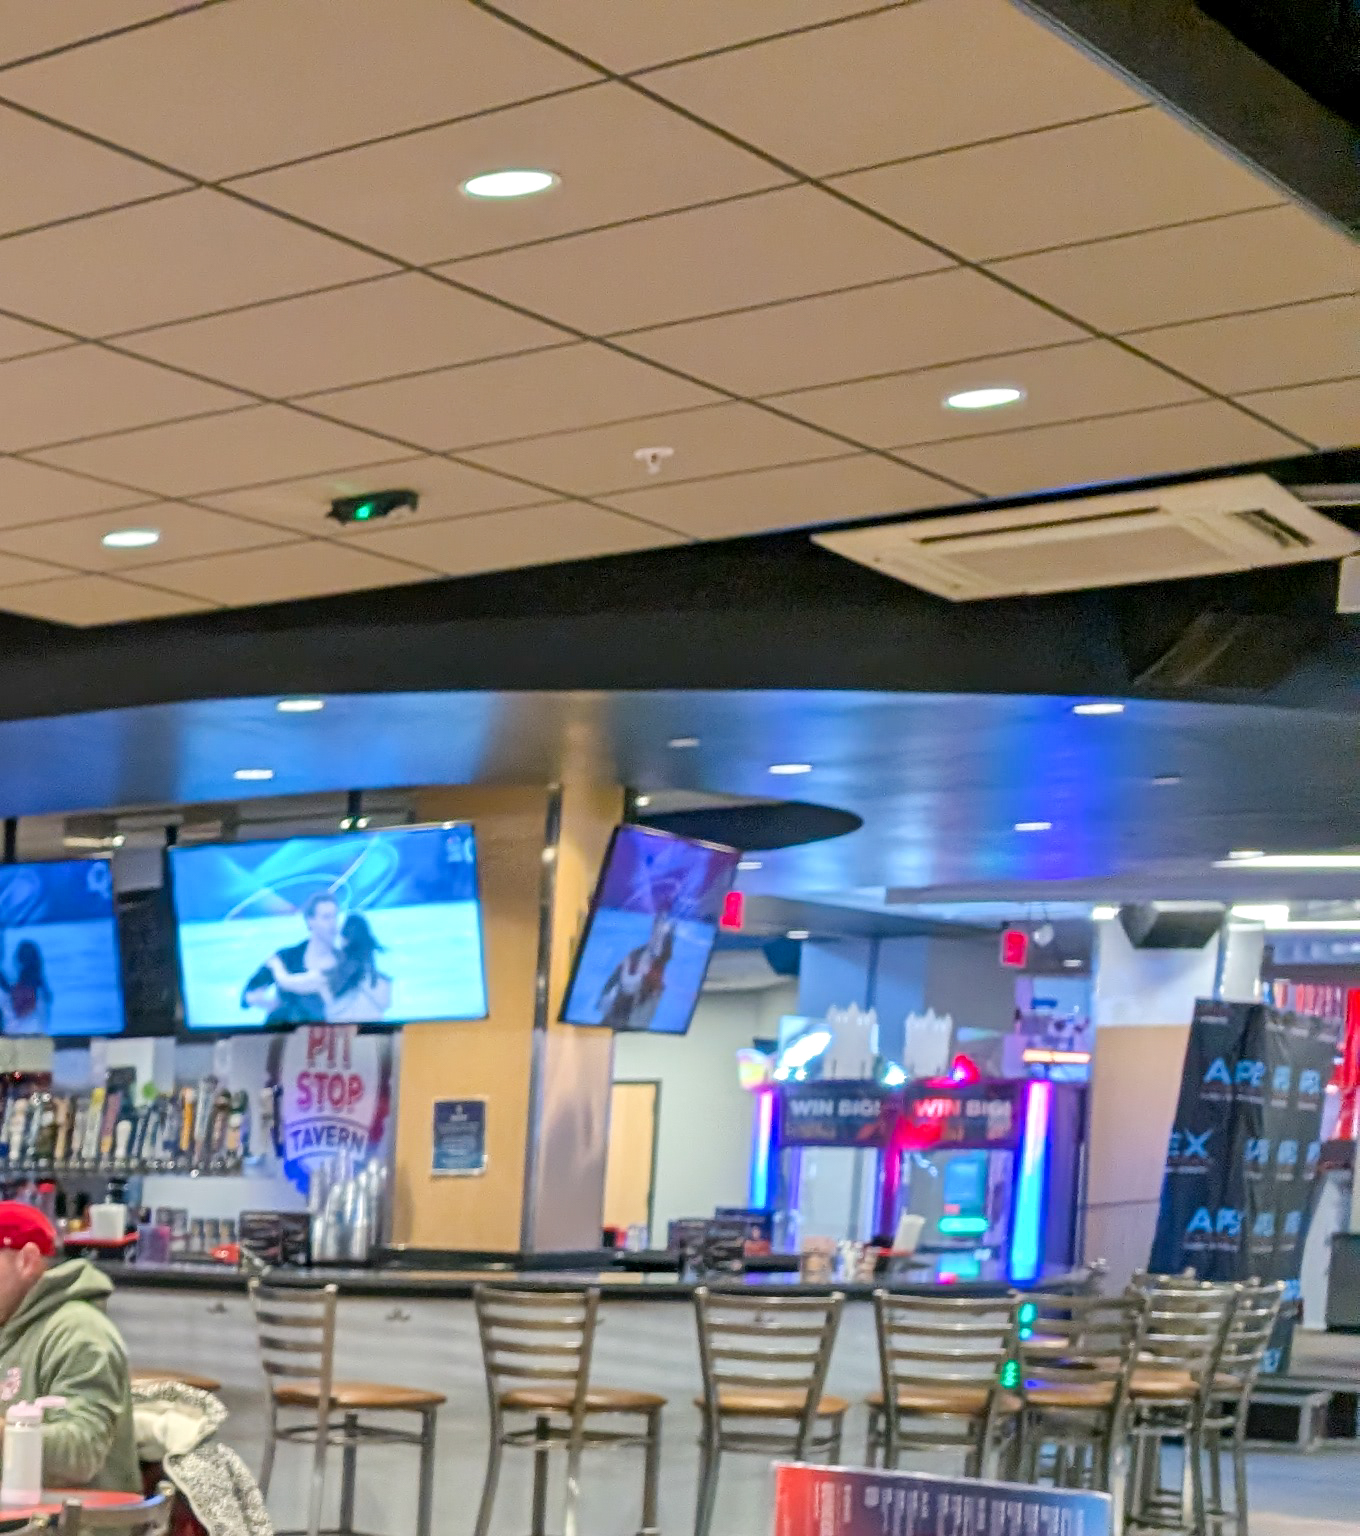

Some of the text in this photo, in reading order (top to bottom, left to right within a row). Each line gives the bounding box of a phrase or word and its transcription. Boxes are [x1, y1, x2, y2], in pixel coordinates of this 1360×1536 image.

[296, 1071, 364, 1113] STOP
[789, 1099, 833, 1117] WIN
[914, 1098, 961, 1118] WIN
[289, 1125, 367, 1153] TAVERN
